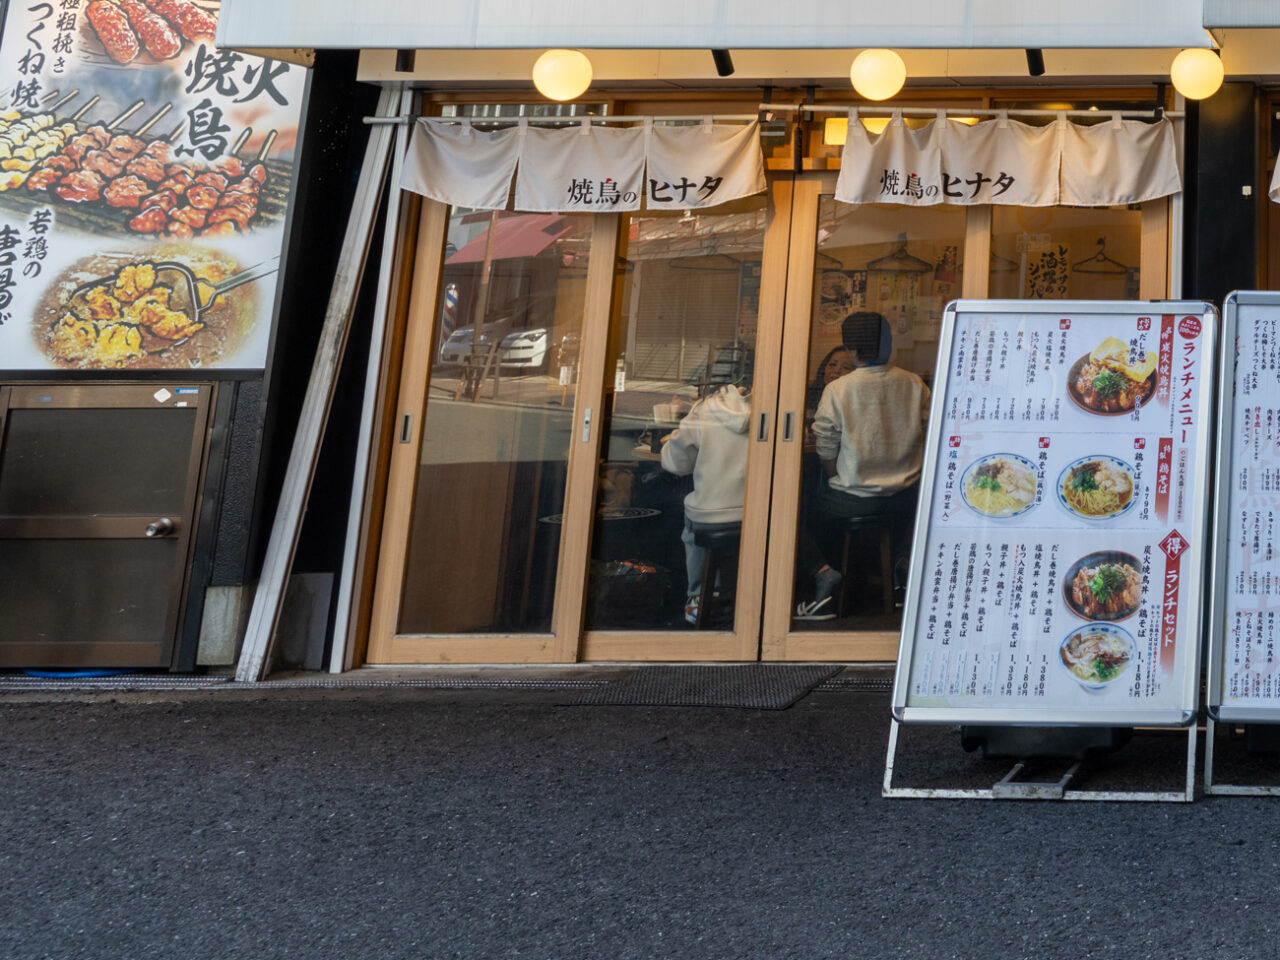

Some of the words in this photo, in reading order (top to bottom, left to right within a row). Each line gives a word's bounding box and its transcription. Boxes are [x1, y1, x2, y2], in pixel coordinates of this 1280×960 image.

[9, 1, 54, 110] つくね焼
[174, 43, 243, 162] 焼鳥
[567, 174, 724, 206] 焼鳥のヒナタ
[879, 169, 1016, 200] 焼鳥のヒナタ
[22, 209, 52, 279] 若鶏の
[1178, 342, 1196, 443] ランチメニュー
[1166, 537, 1182, 554] 得
[1163, 570, 1179, 647] ランチセット
